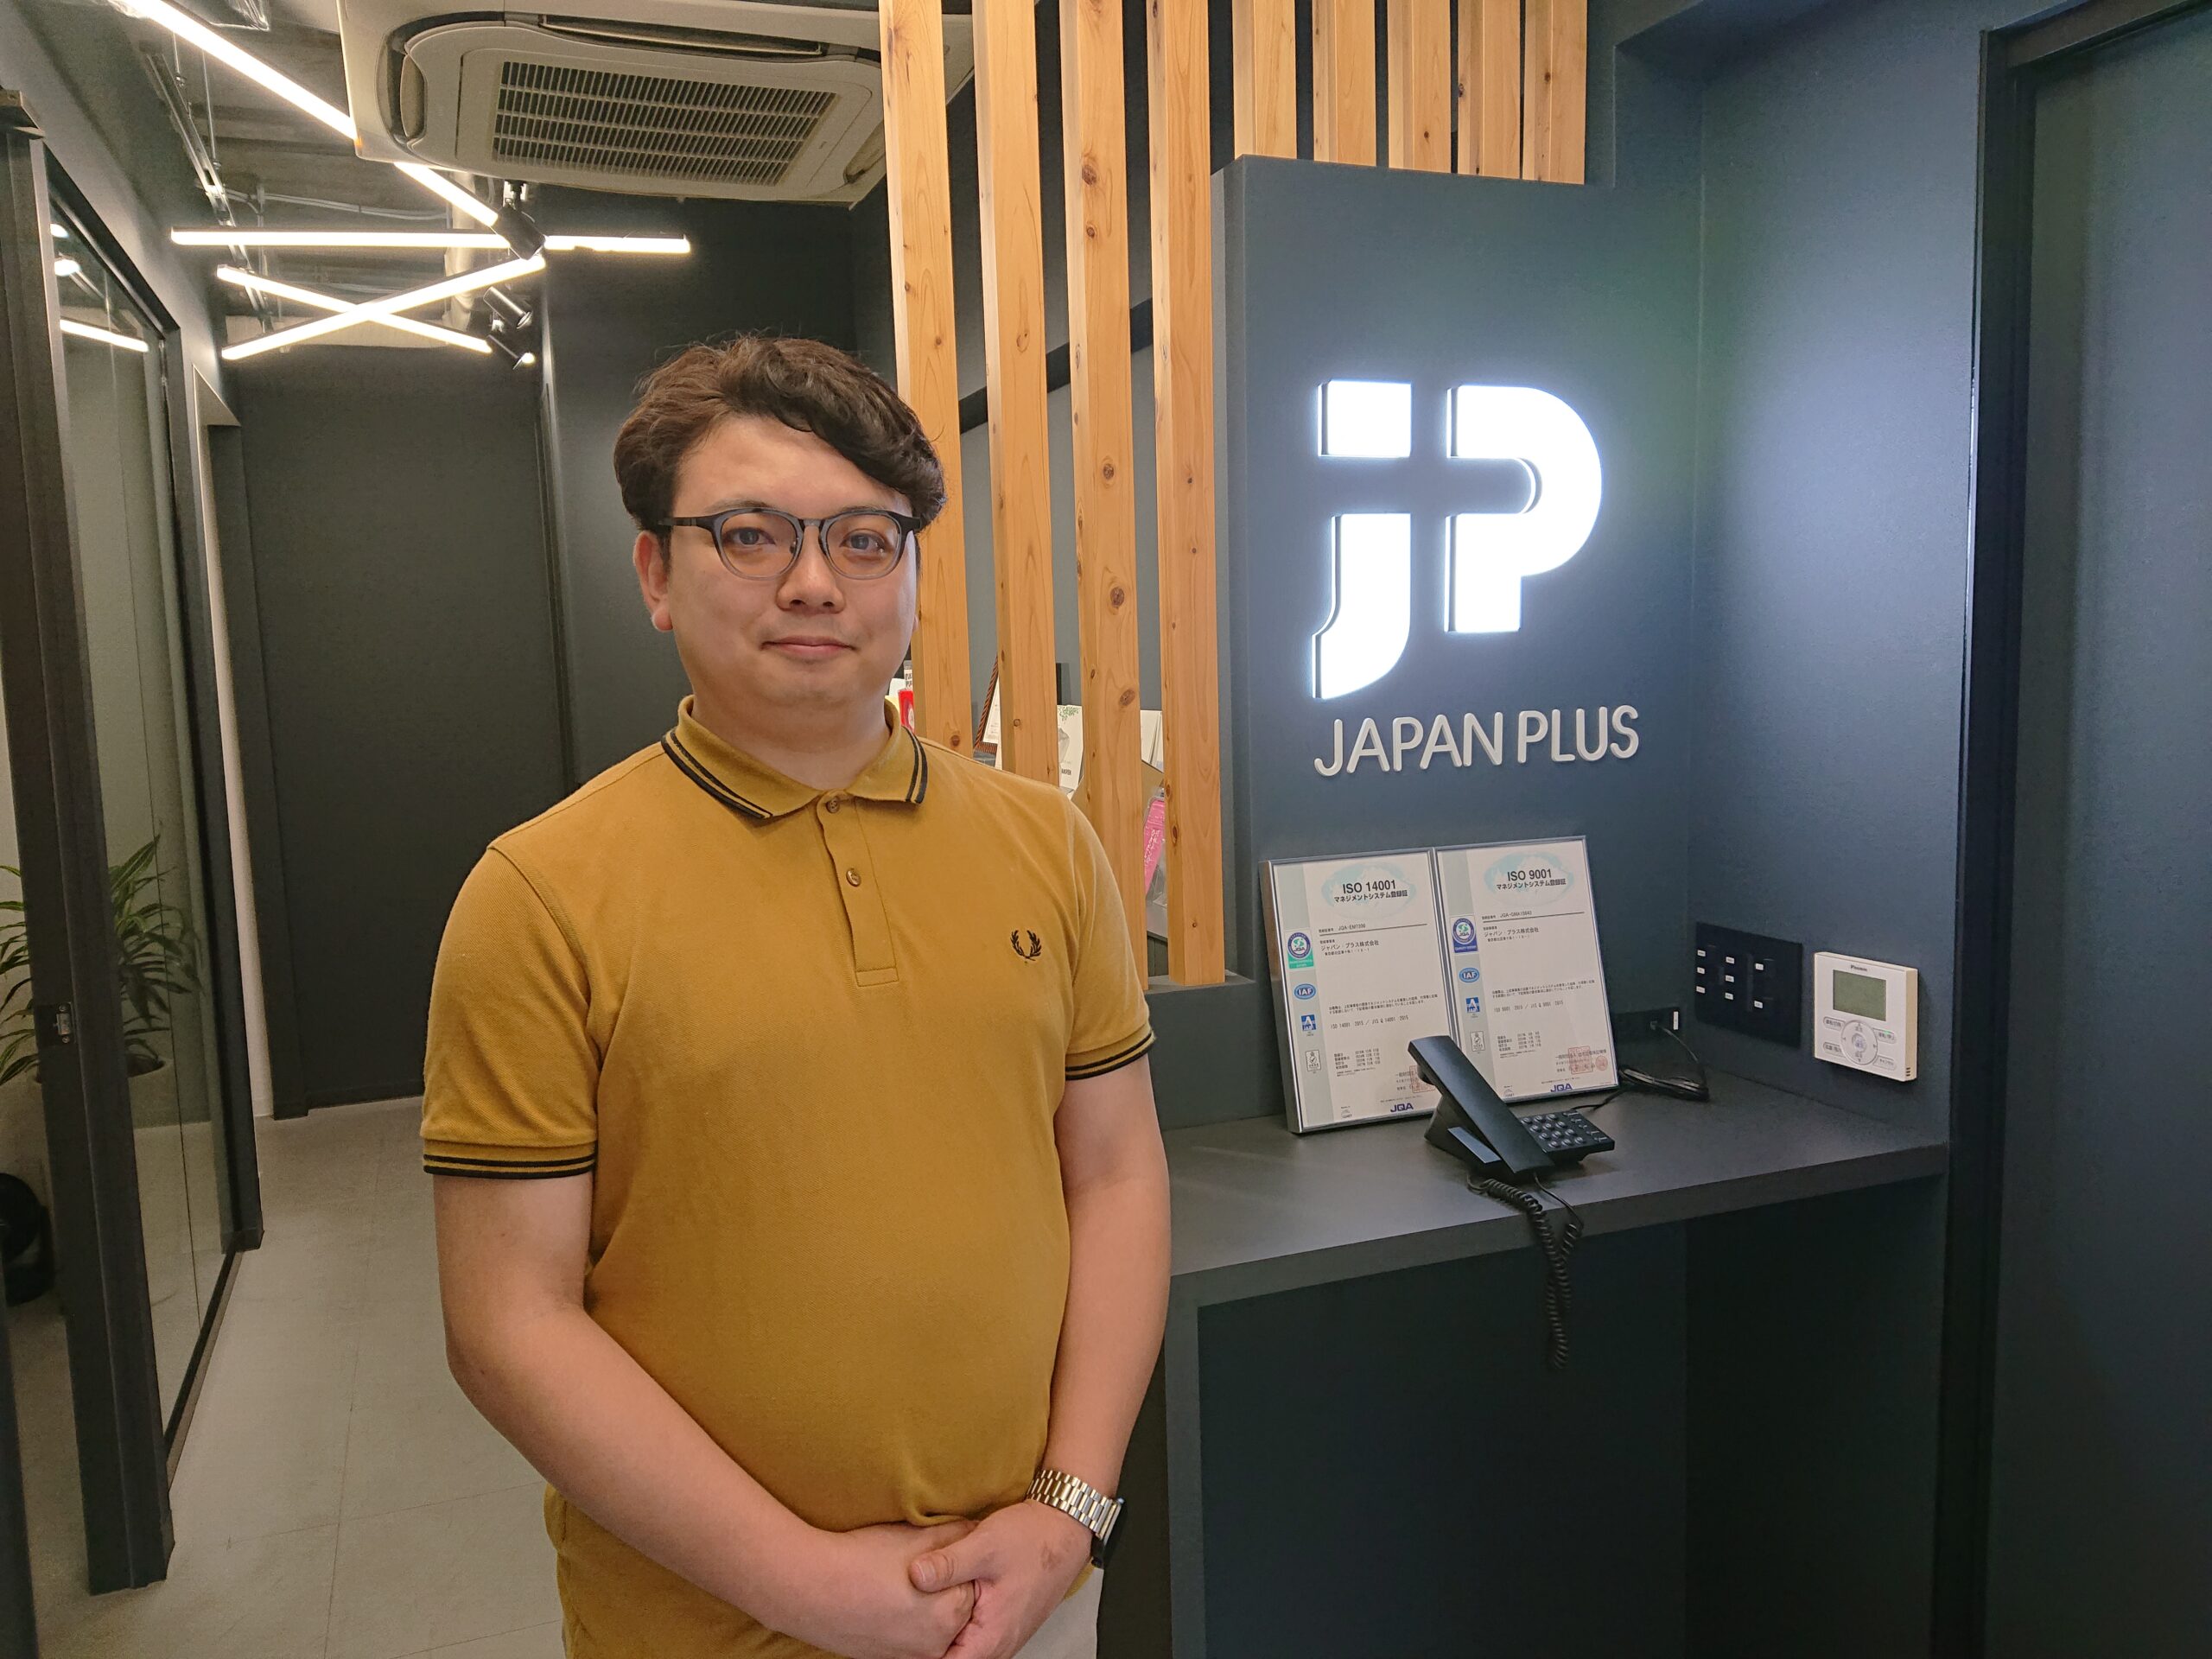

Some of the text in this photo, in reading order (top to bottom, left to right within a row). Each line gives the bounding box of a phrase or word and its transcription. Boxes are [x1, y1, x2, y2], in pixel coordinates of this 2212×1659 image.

[1313, 704, 1639, 778] JAPAN PLUS
[1507, 868, 1552, 881] ISO 9001
[1342, 880, 1396, 894] ISO 14001
[1550, 1083, 1573, 1092] JQA
[1389, 1103, 1414, 1112] JQA
